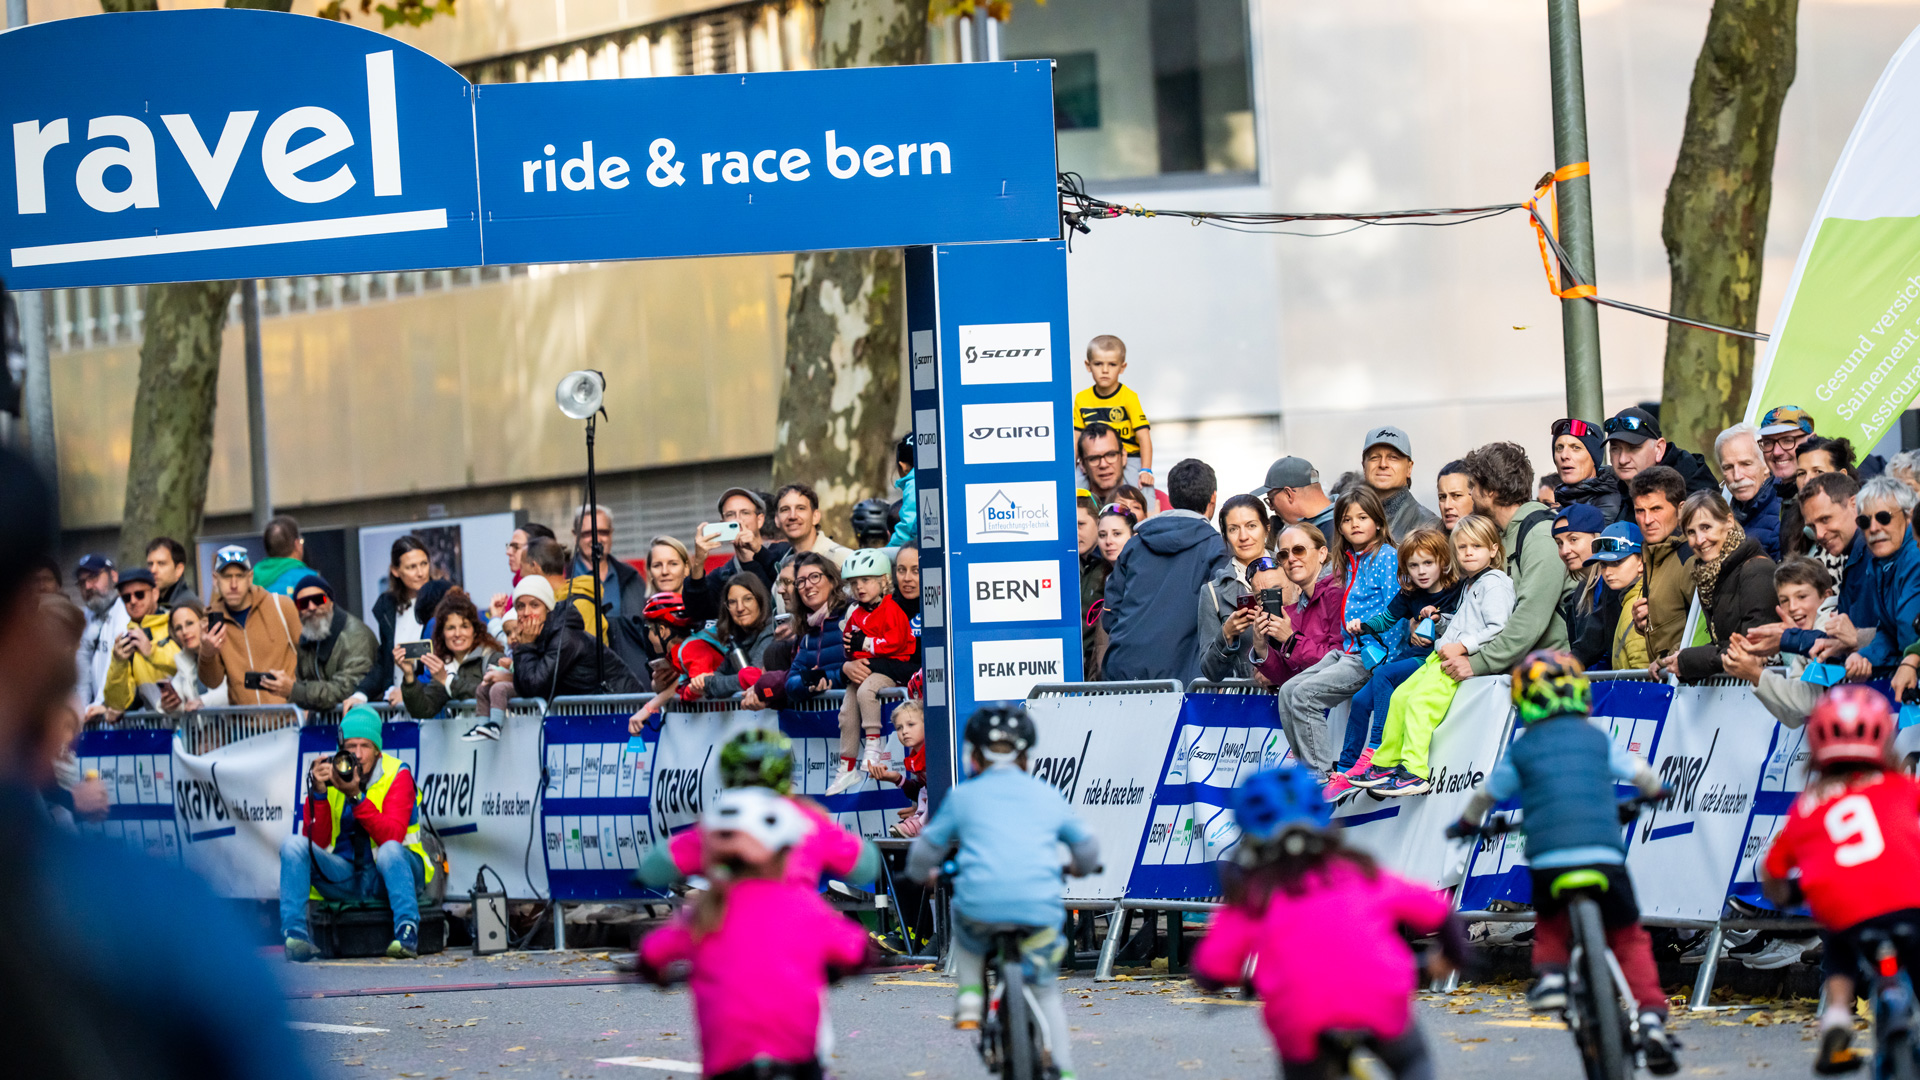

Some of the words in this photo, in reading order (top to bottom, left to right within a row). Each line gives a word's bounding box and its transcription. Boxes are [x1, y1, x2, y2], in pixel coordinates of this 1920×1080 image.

[522, 140, 630, 193] ride
[646, 138, 686, 188] &
[701, 148, 810, 185] race
[825, 130, 952, 179] bern
[918, 355, 932, 365] SCOTT
[980, 348, 1045, 358] SCOTT
[1816, 334, 1876, 401] Gesund
[1836, 328, 1920, 421] Sainement
[1860, 358, 1920, 441] Assicura
[924, 433, 936, 445] GIRO
[996, 425, 1050, 438] GIRO
[988, 503, 1049, 520] BasiTrock
[925, 586, 939, 608] BERN
[976, 579, 1040, 602] BERN
[978, 662, 1016, 677] PEAK
[1018, 660, 1058, 676] PUNK
[810, 762, 825, 770] SCOTT
[1032, 729, 1092, 804] ravel
[1193, 751, 1217, 761] SCOTT
[421, 749, 477, 818] gravel
[656, 744, 713, 840] gravel
[1083, 778, 1102, 805] ride
[1101, 778, 1111, 805] &
[1109, 786, 1127, 805] race
[1127, 777, 1144, 805] bern
[1436, 766, 1447, 795] &
[176, 762, 230, 844] gravel
[250, 806, 264, 821] race
[265, 798, 283, 821] bern
[481, 792, 495, 816] ride
[496, 792, 501, 816] &
[502, 799, 515, 816] race
[516, 791, 530, 816] bern
[1699, 783, 1718, 812] ride
[547, 832, 560, 853] BERN
[1149, 823, 1168, 846] BERN
[1824, 794, 1885, 867] 9
